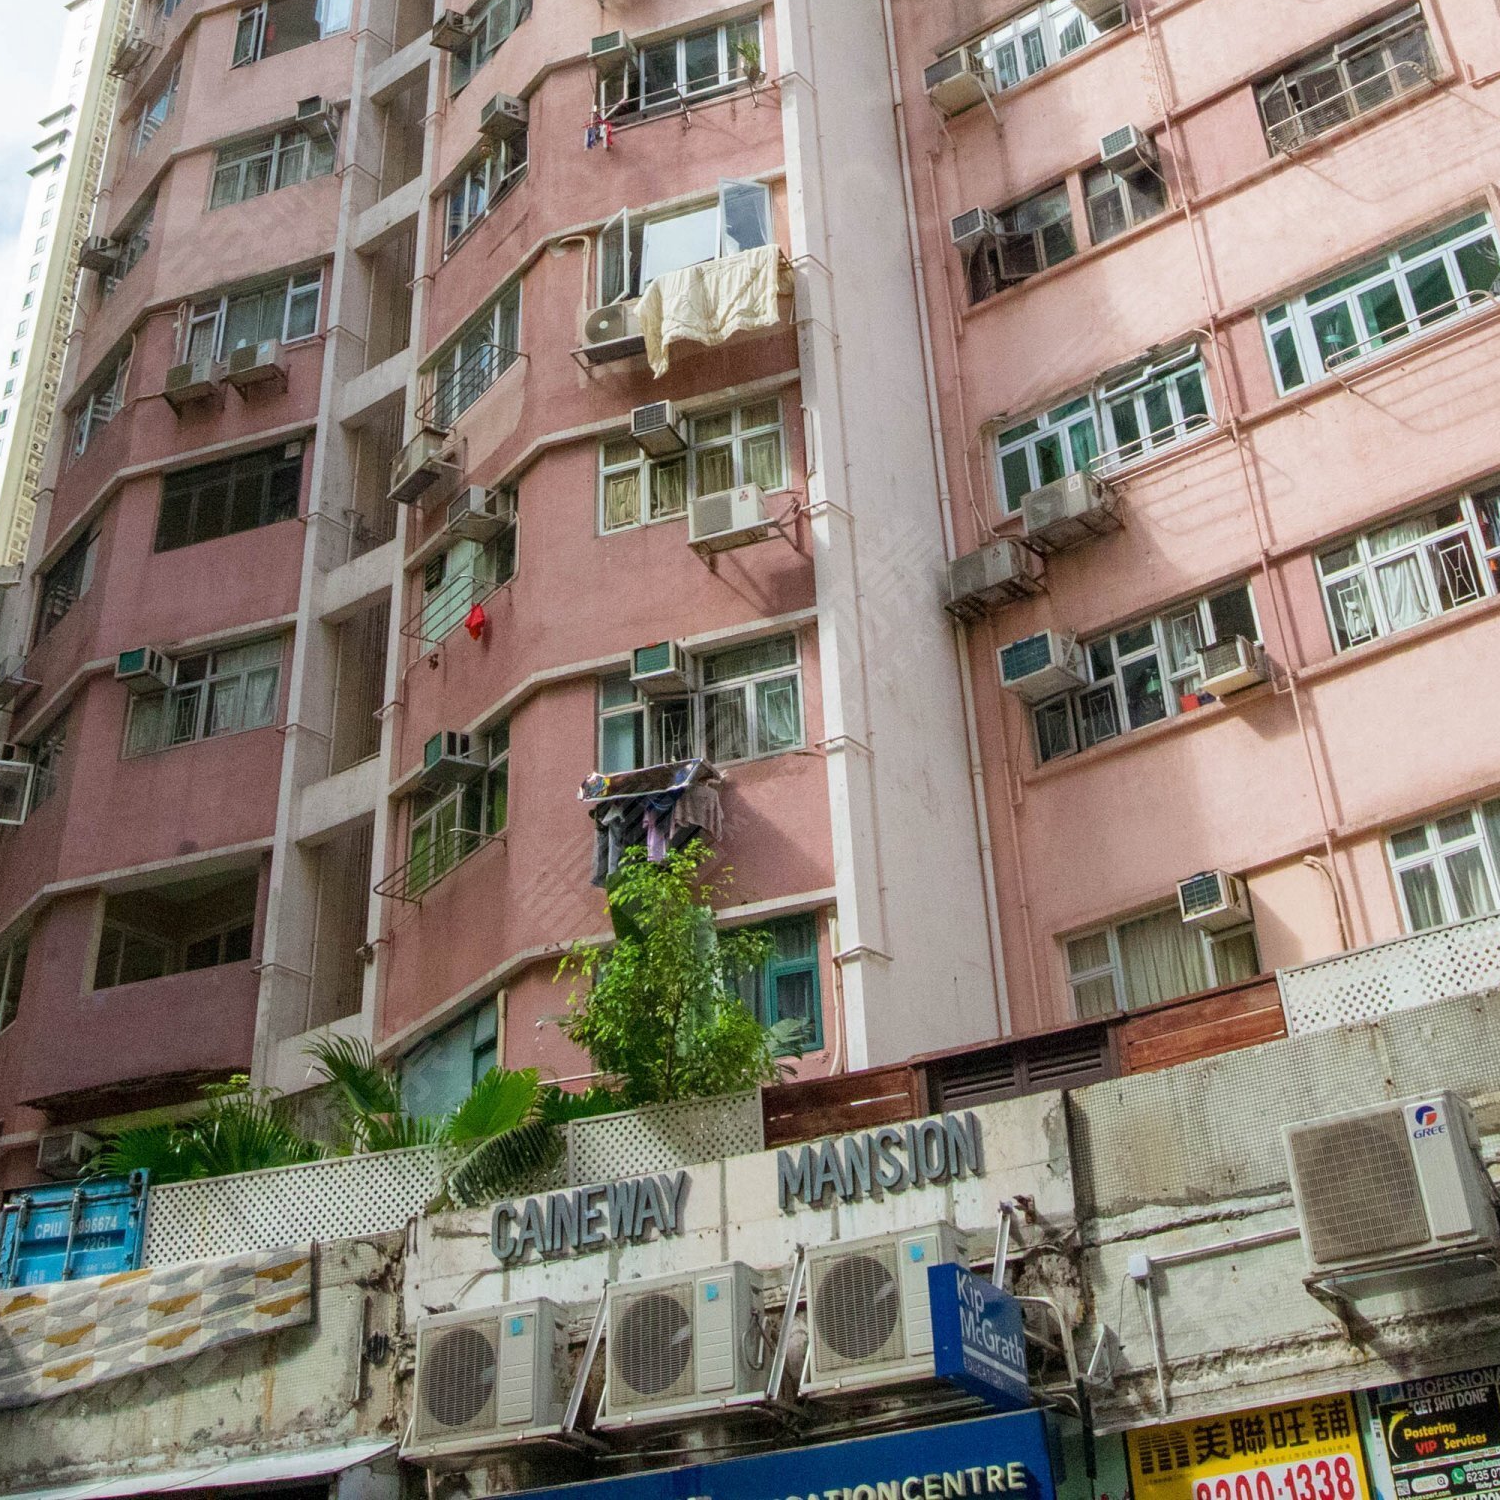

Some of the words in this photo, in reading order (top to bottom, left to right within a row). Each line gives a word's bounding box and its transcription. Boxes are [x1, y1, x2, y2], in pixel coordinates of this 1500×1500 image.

[1412, 1124, 1446, 1139] GREE
[490, 1169, 691, 1261] CAINEWAY
[776, 1111, 985, 1209] MANSION
[34, 1221, 62, 1240] CPIU
[956, 1269, 985, 1323] Kip
[959, 1305, 1026, 1369] McGrath
[1435, 1395, 1456, 1413] SHIT
[1193, 1400, 1352, 1466] 美聯旺舖
[1404, 1422, 1457, 1440] Postering
[1415, 1440, 1438, 1456] VIP
[1444, 1433, 1488, 1450] Services
[1466, 1471, 1489, 1483] 6235
